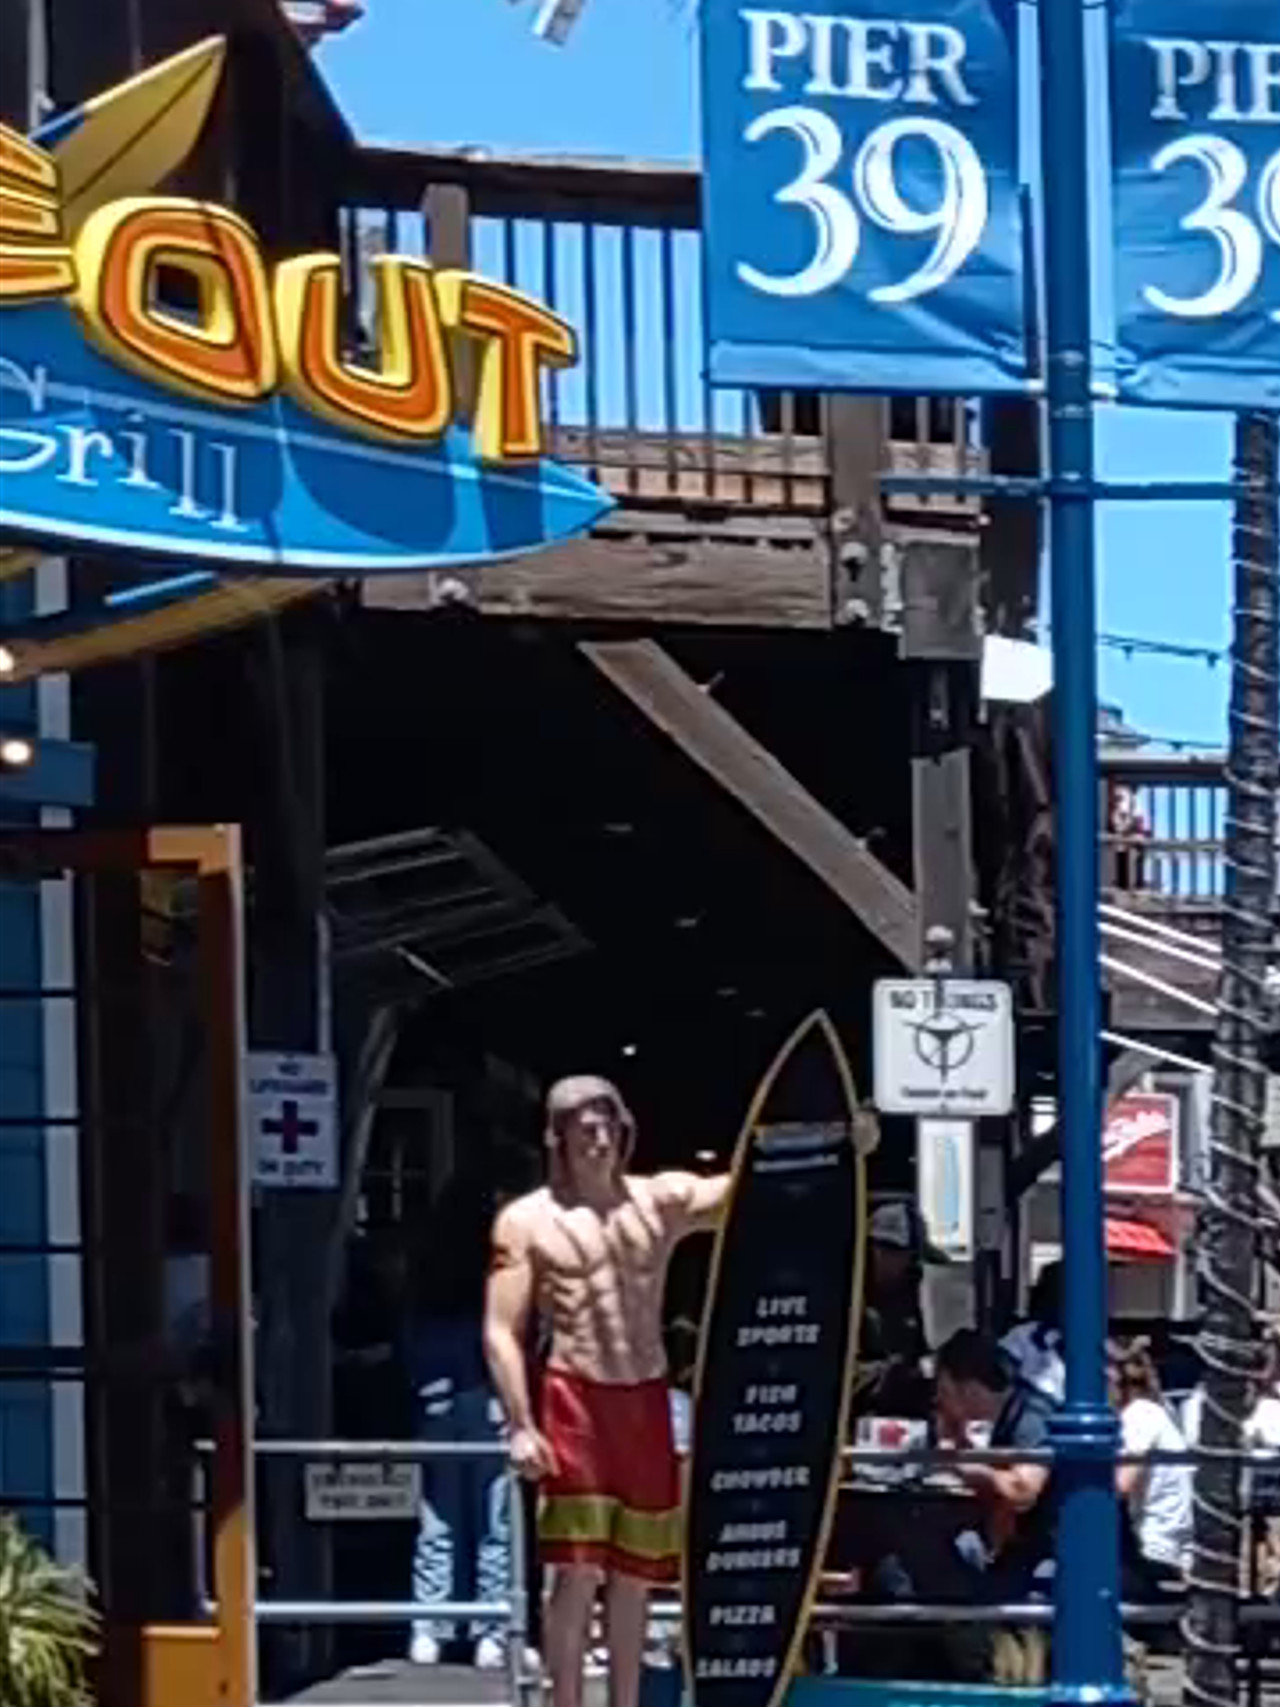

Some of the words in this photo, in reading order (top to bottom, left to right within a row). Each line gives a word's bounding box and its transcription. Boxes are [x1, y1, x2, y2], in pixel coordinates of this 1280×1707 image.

[737, 7, 978, 106] PIER
[736, 104, 990, 305] 39
[755, 1295, 807, 1318] LIVE
[736, 1323, 821, 1347] SPORTS
[732, 1411, 803, 1434] TACOS
[709, 1465, 811, 1493] CHOWDER
[705, 1547, 801, 1573] BURGERS
[708, 1604, 776, 1626] PIZZA
[694, 1655, 778, 1679] SALADS
